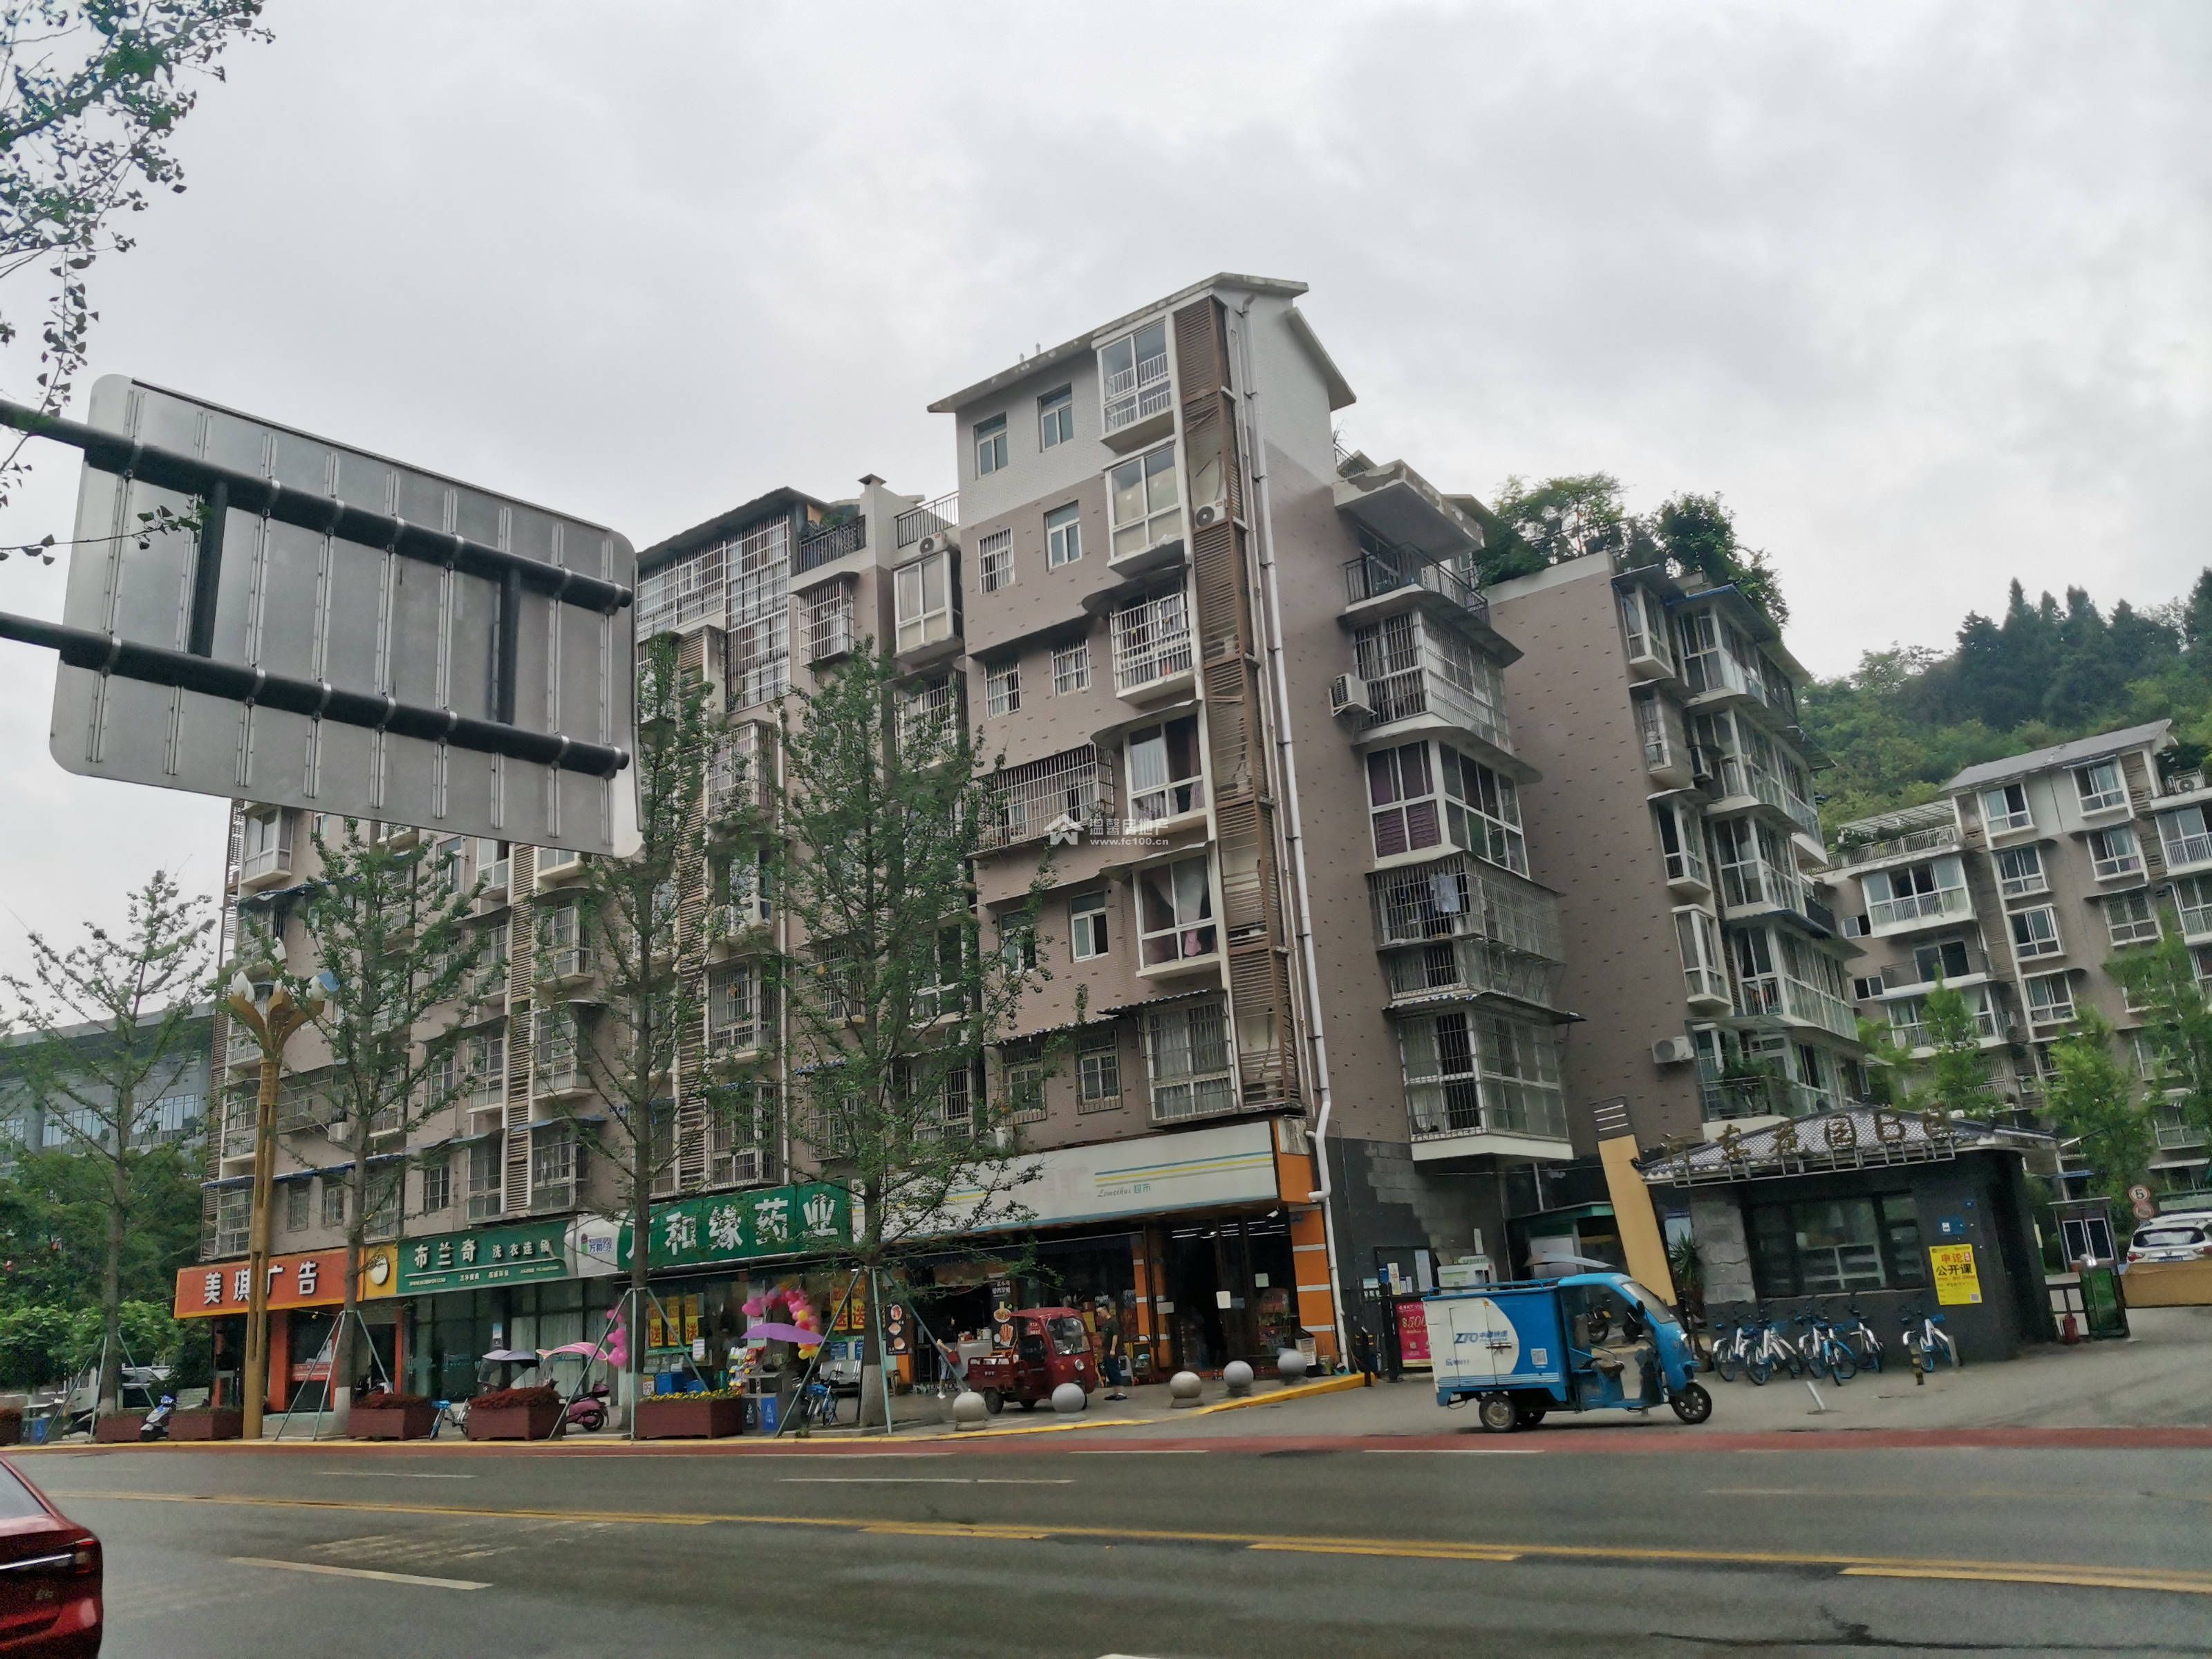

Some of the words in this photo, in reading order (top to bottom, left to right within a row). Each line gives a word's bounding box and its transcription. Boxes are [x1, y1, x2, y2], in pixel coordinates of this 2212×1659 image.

[414, 1239, 476, 1268] 布兰奇
[1941, 1253, 1962, 1264] 申论
[1936, 1264, 1973, 1276] 公开课
[1454, 1332, 1479, 1344] ZTO
